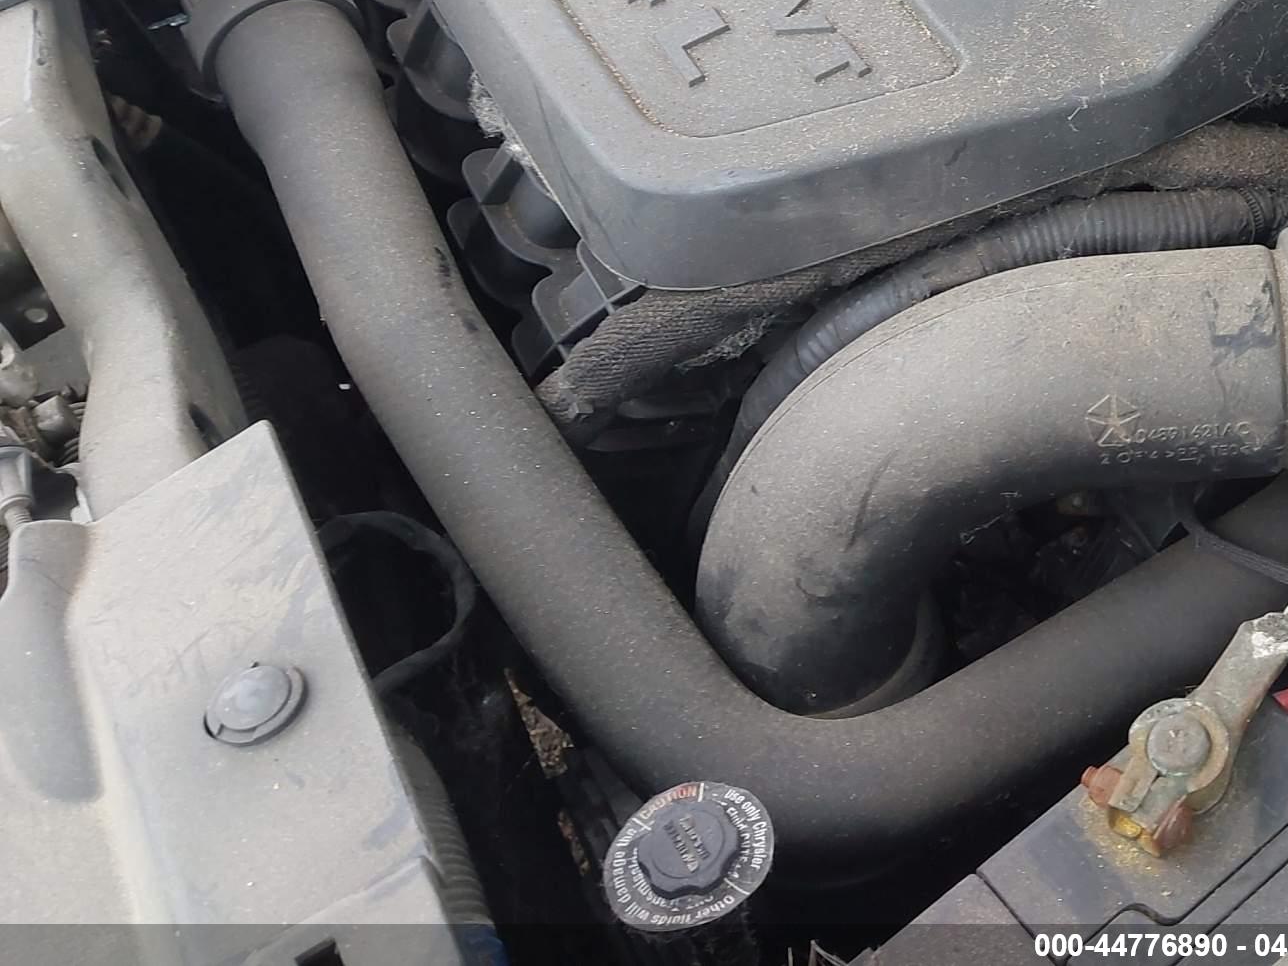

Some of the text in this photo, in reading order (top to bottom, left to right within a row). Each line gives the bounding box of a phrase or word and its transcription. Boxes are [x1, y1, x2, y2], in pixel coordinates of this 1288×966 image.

[615, 828, 638, 847] the
[724, 788, 768, 870] Use only Chrysler
[612, 850, 632, 904] damage
[624, 901, 651, 922] will
[694, 894, 736, 919] Other
